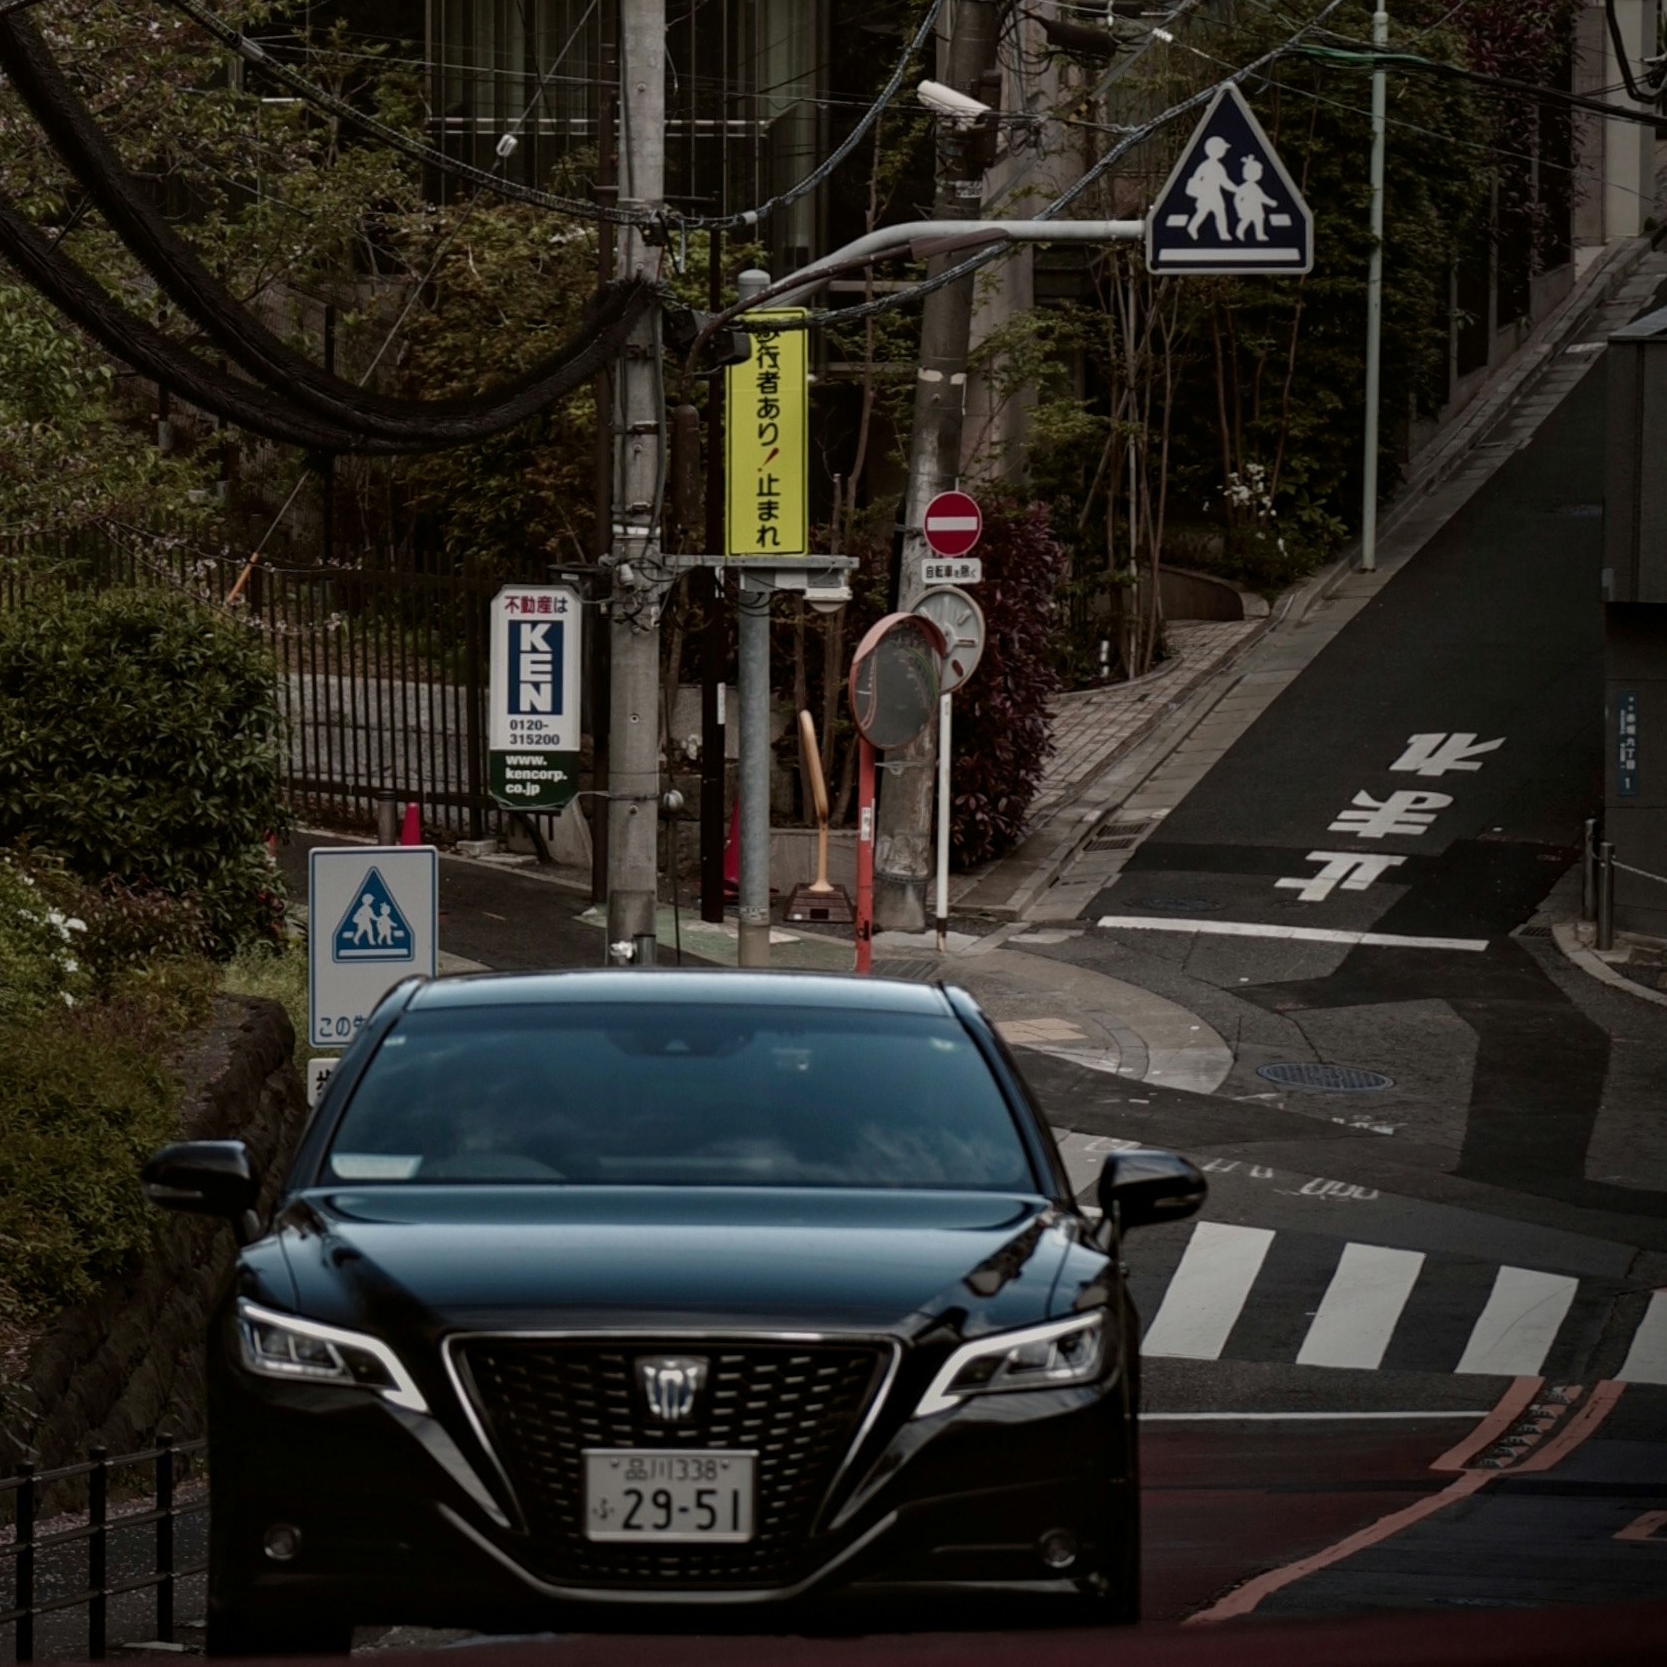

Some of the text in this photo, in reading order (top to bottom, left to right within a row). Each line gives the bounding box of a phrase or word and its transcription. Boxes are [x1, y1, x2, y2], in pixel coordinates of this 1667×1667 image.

[504, 595, 568, 615] 不動産は
[518, 622, 554, 713] KEN
[510, 720, 549, 731] 0120-
[510, 734, 560, 746] 315200
[505, 755, 547, 766] www.
[505, 767, 568, 784] kencorp.
[505, 781, 541, 796] co.jp
[625, 1457, 718, 1481] 品川 338
[622, 1489, 740, 1531] 29-51
